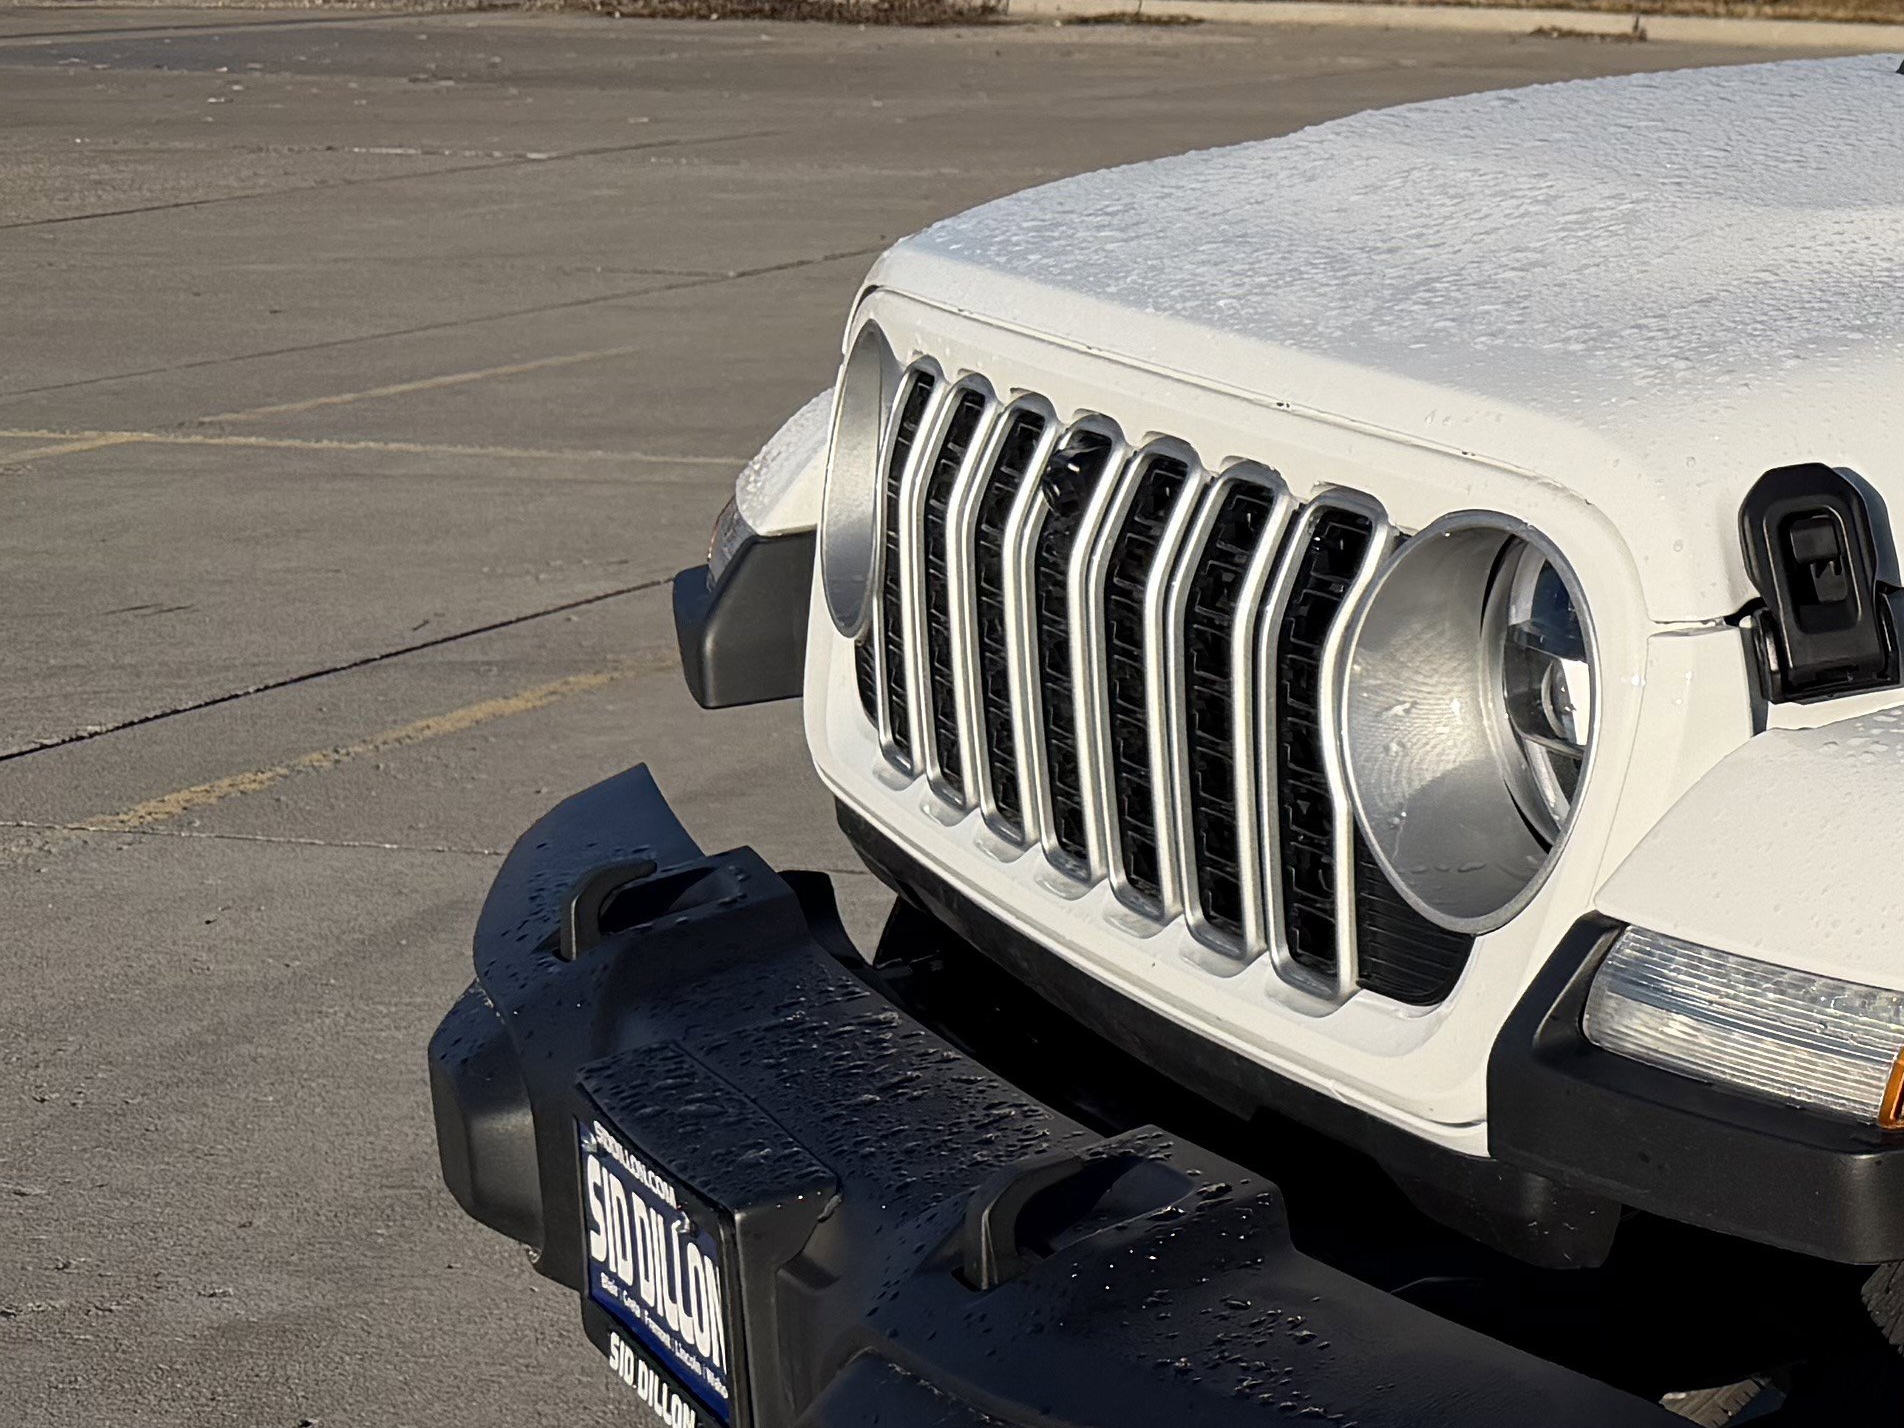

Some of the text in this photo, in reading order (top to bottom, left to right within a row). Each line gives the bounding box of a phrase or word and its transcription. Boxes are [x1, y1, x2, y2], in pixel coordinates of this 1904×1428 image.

[587, 1154, 728, 1376] SID DILLON
[609, 1331, 635, 1387] SID
